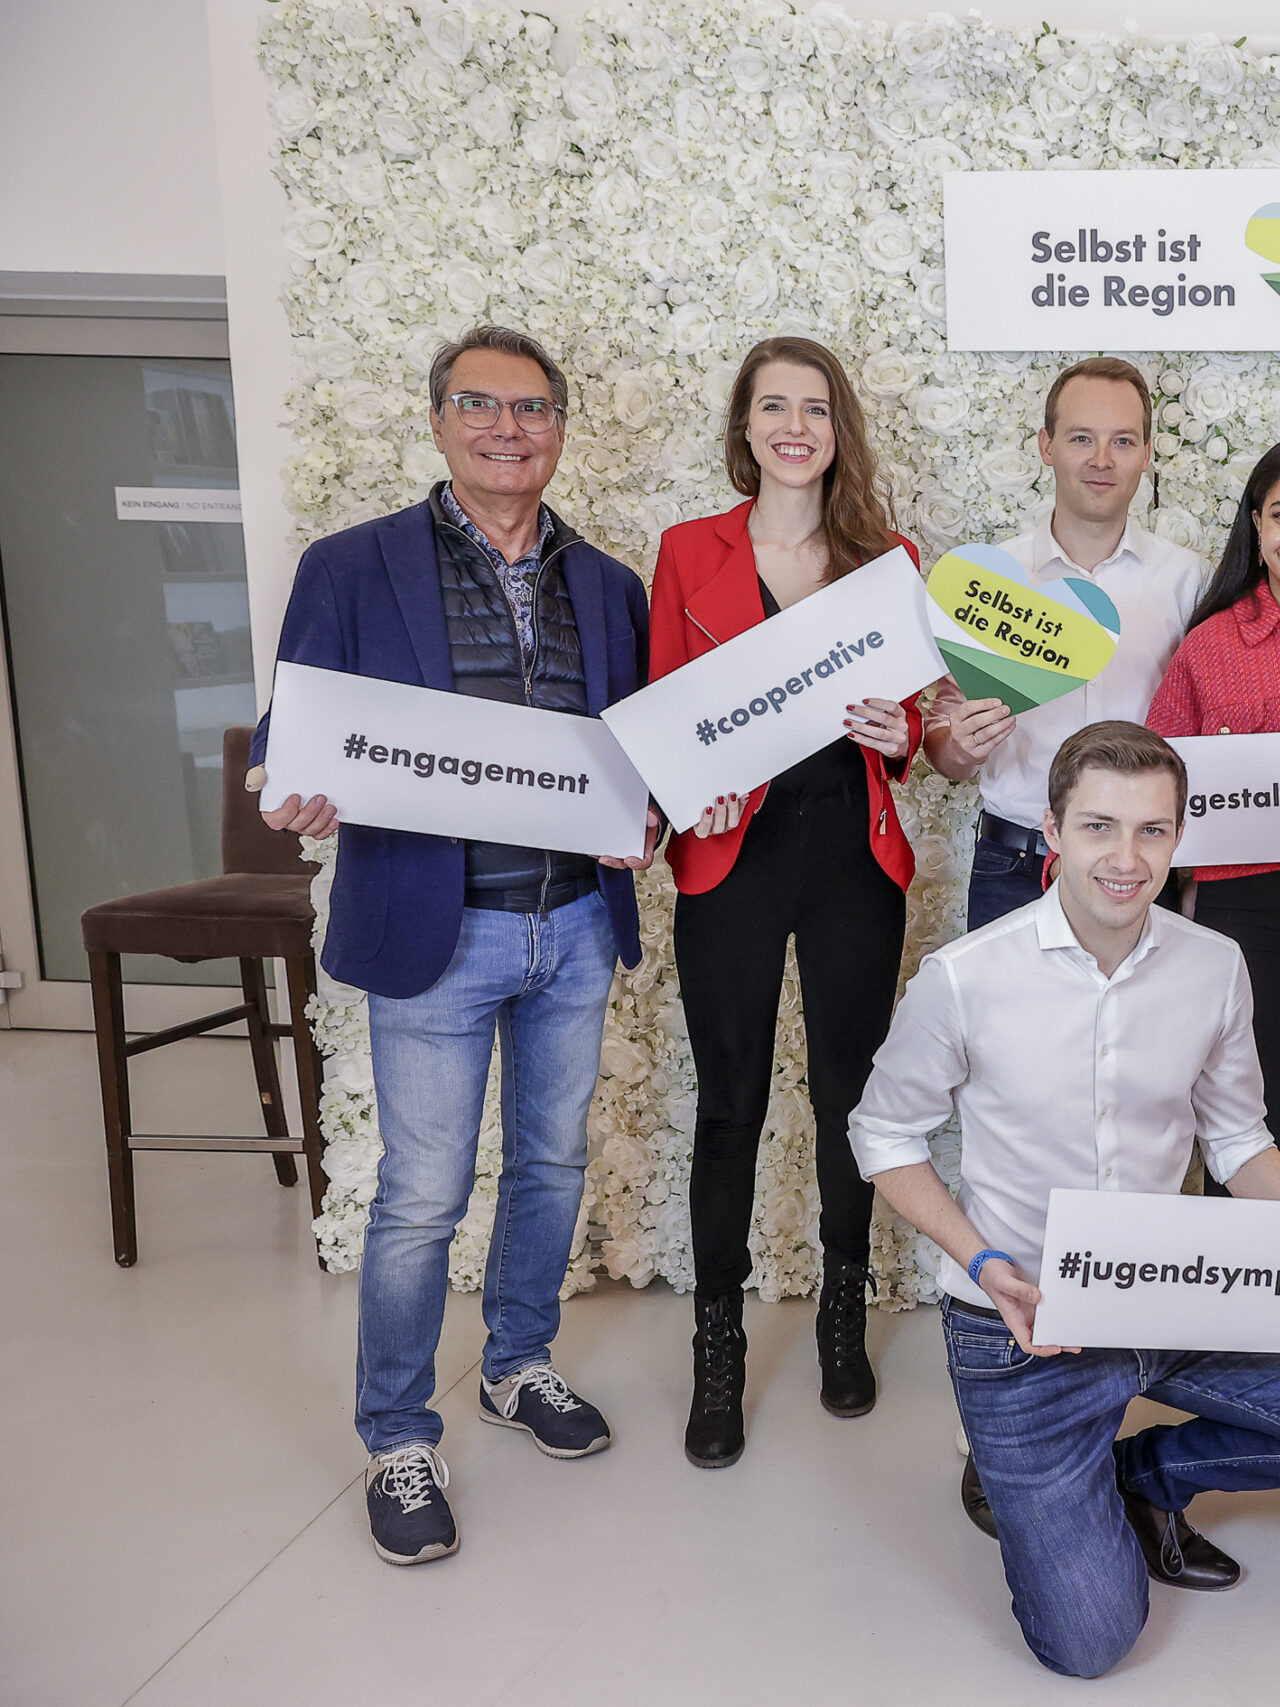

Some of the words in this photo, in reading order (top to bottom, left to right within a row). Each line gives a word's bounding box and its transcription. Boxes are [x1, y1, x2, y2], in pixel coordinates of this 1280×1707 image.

[1031, 229, 1147, 263] Selbst
[1157, 229, 1201, 262] ist
[1031, 273, 1090, 307] die
[1103, 273, 1236, 316] Region
[121, 500, 141, 508] KEIN
[143, 500, 180, 509] EINGANG
[186, 502, 200, 510] NO
[954, 605, 989, 631] die
[994, 620, 1070, 669] Region
[964, 580, 1033, 623] Selbst
[1035, 611, 1063, 637] ist
[695, 630, 885, 746] #cooperative
[343, 733, 590, 795] #engagement
